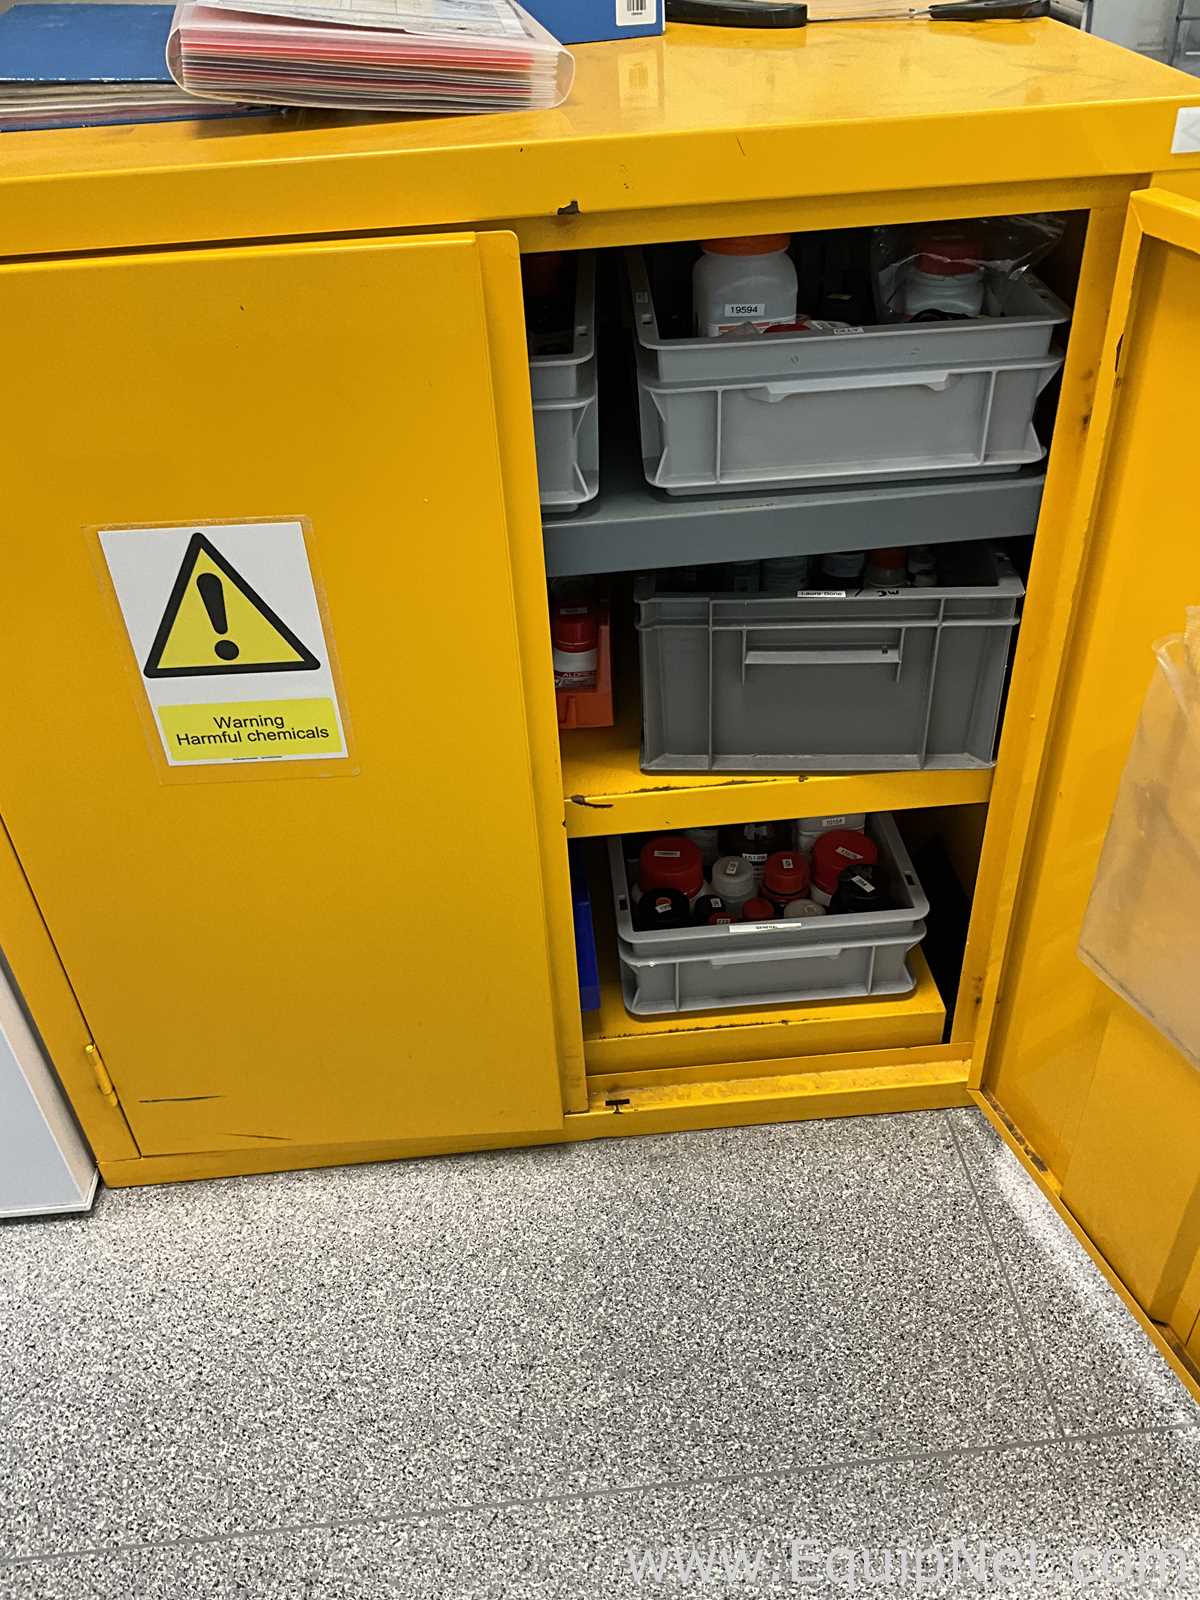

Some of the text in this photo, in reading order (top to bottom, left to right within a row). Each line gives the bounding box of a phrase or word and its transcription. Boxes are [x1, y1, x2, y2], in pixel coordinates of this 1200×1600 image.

[730, 306, 758, 314] 19594
[213, 715, 285, 730] Warning
[176, 726, 329, 746] Harmful chemicals
